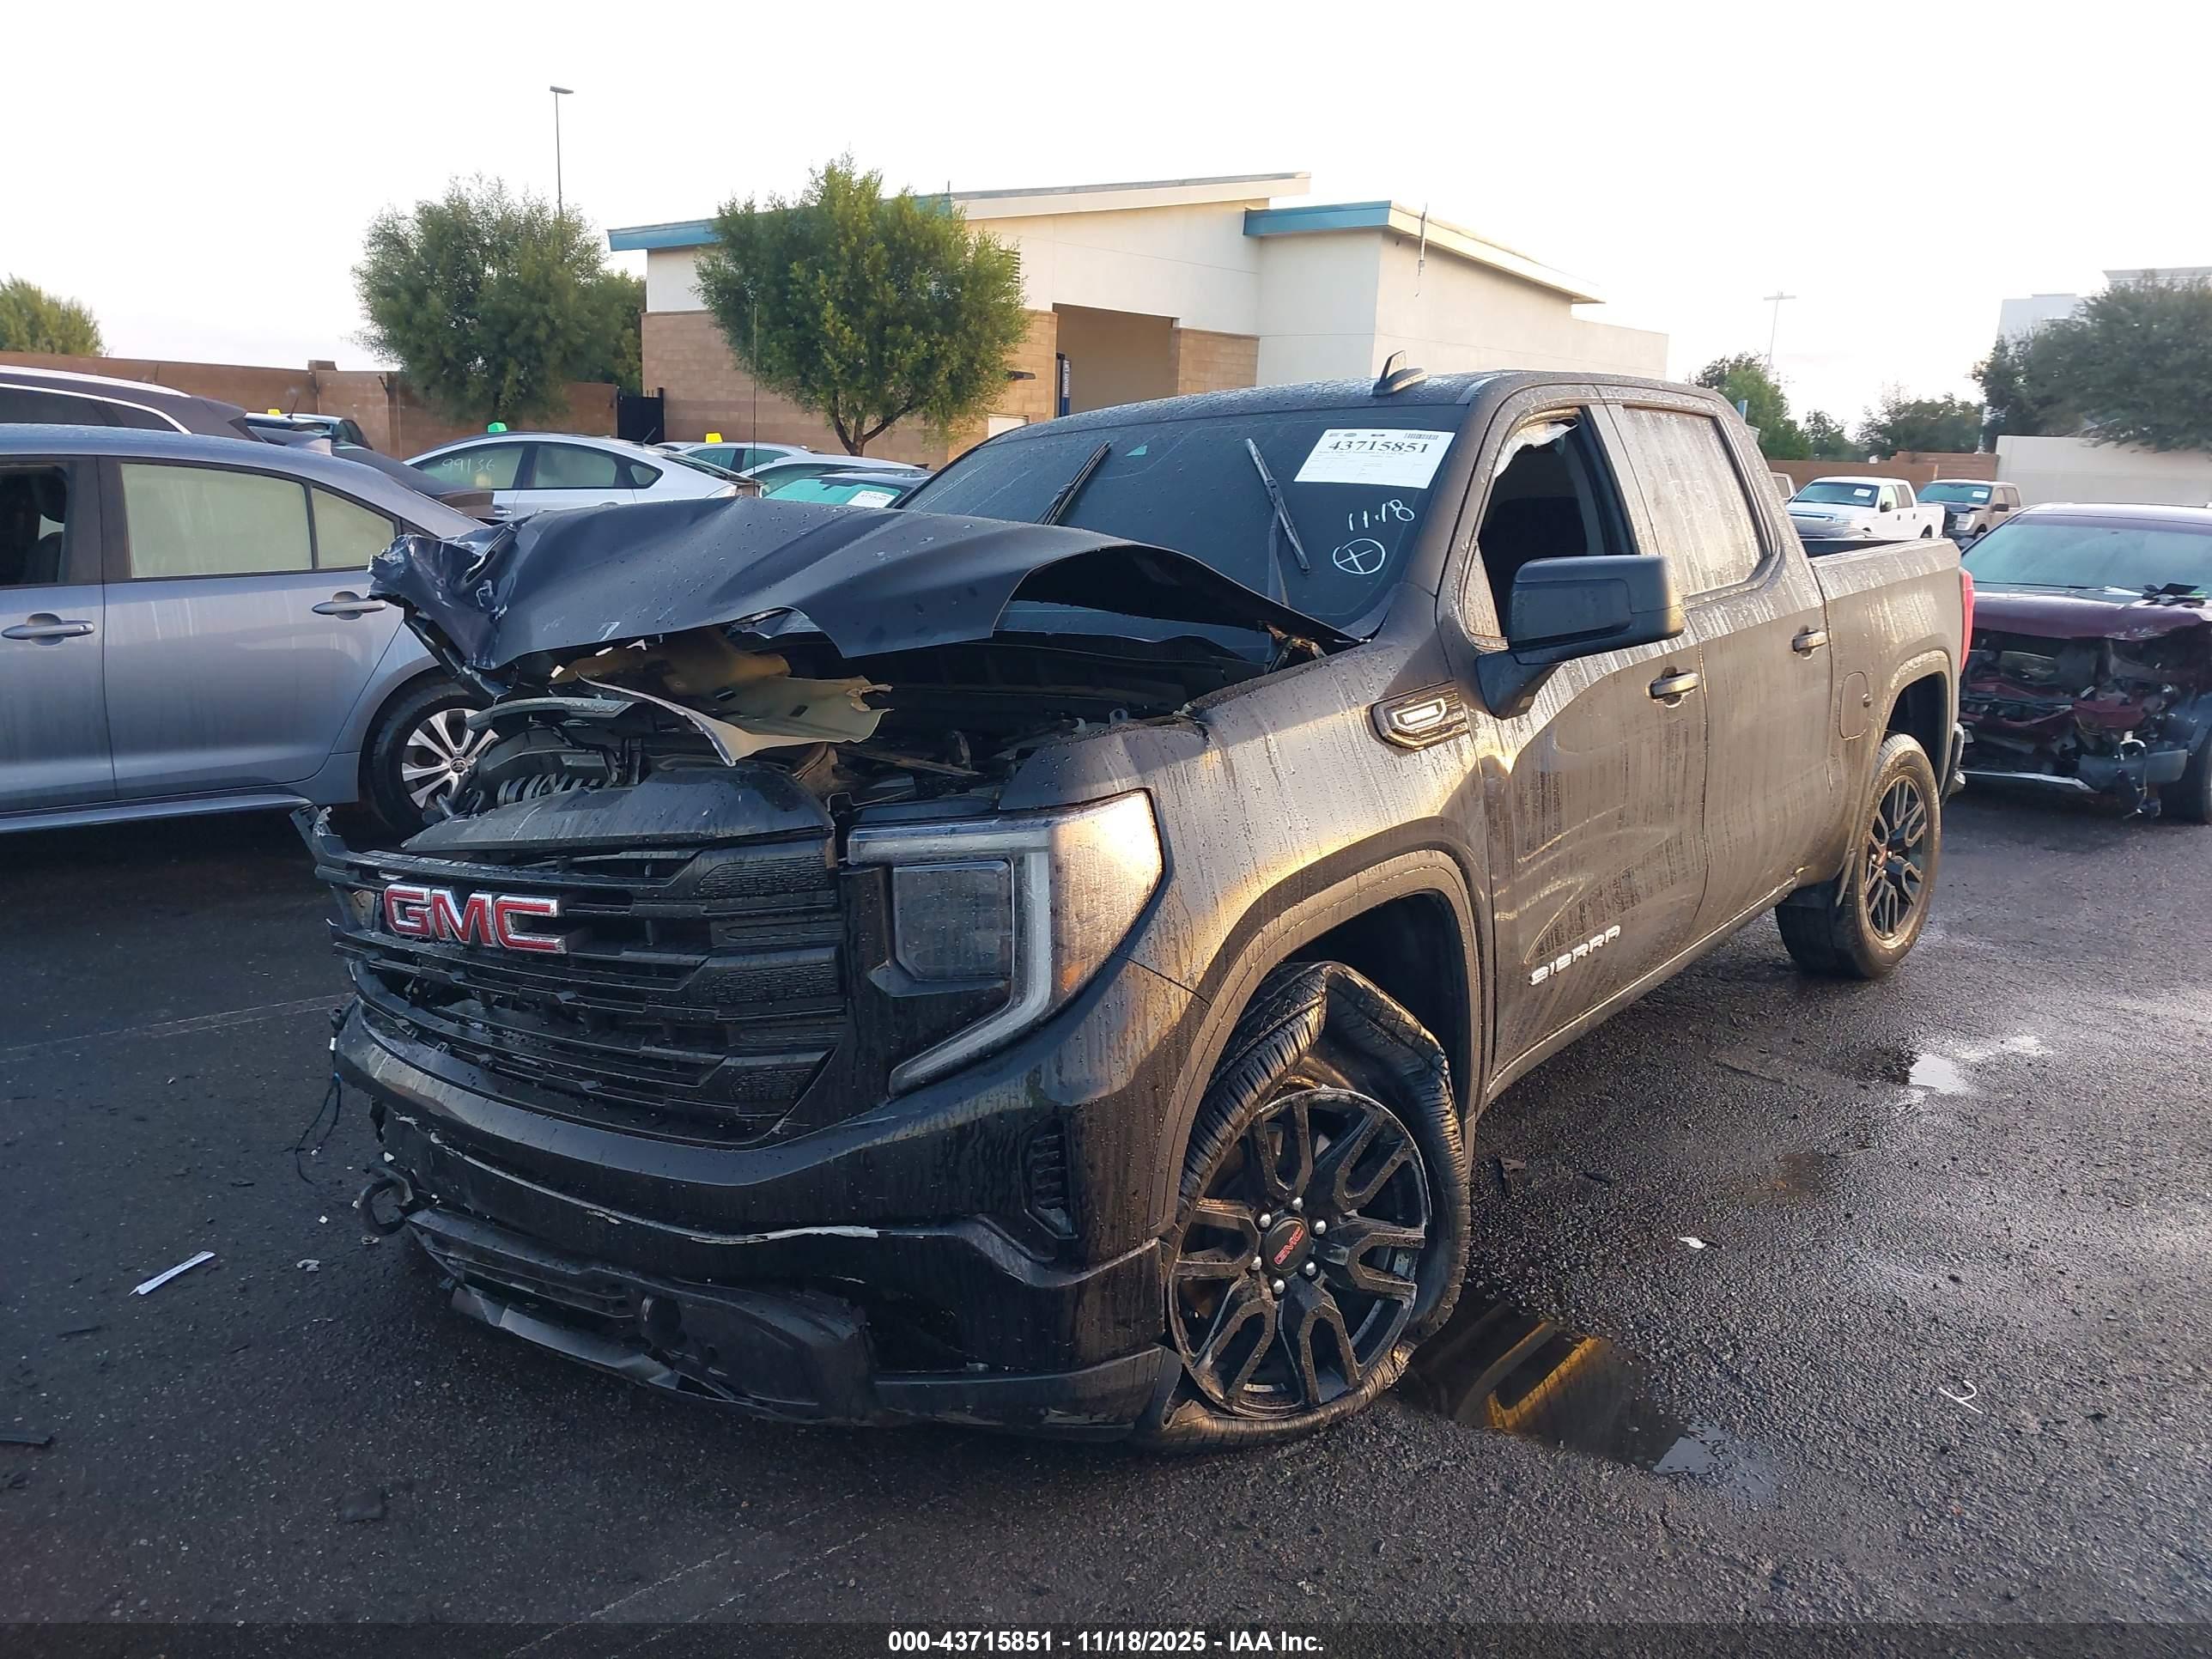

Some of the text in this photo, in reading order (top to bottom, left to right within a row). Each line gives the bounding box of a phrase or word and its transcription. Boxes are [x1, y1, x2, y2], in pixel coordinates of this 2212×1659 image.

[1328, 441, 1430, 453] 43715851
[384, 884, 568, 954] GMC
[1529, 924, 1621, 986] SIERRA
[1273, 1225, 1304, 1265] GMC
